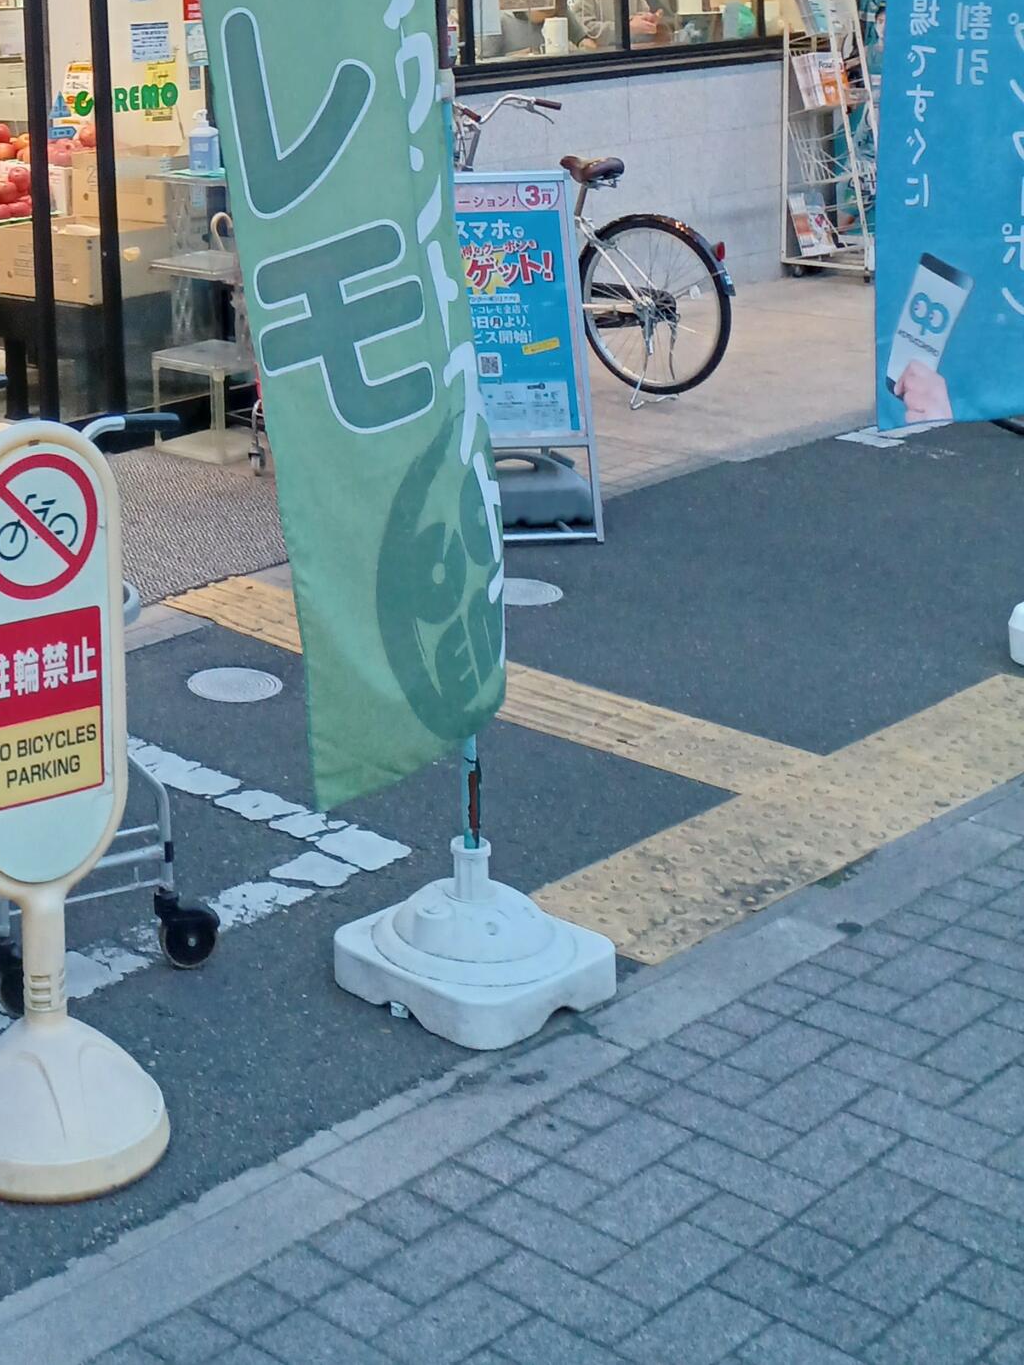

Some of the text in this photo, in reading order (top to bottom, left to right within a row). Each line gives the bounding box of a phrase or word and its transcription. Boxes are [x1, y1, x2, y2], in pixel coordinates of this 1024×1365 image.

[74, 82, 179, 117] CREMO
[525, 185, 552, 207] 3月
[465, 250, 554, 289] ゲット!
[16, 723, 97, 758] BICYCLES
[6, 754, 81, 788] PARKING
